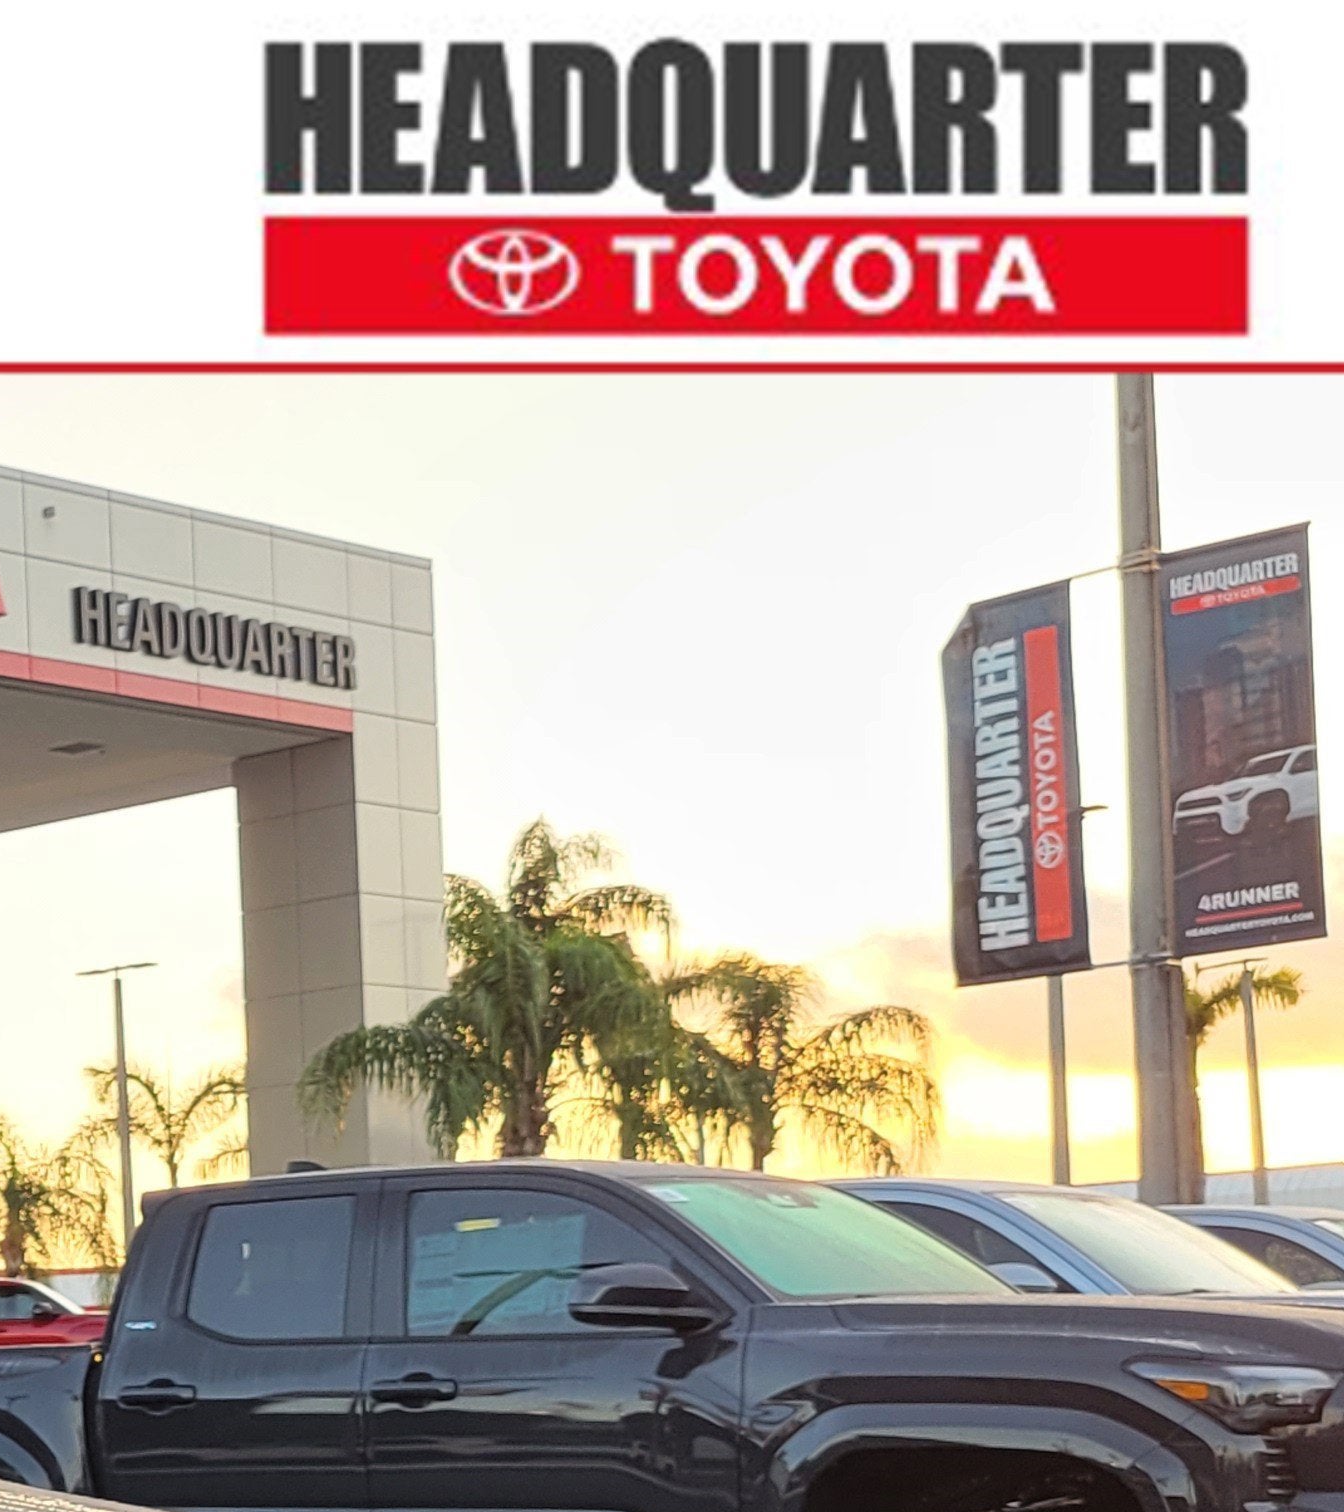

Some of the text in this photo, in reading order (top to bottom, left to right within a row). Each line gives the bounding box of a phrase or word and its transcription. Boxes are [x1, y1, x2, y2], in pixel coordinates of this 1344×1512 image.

[1170, 552, 1298, 599] HEADQUARTER
[72, 586, 358, 690] HEADQUARTER
[972, 637, 1030, 951] HEADQUARTER
[1033, 710, 1058, 830] TOYOTA
[1197, 881, 1300, 912] 4RUNNER
